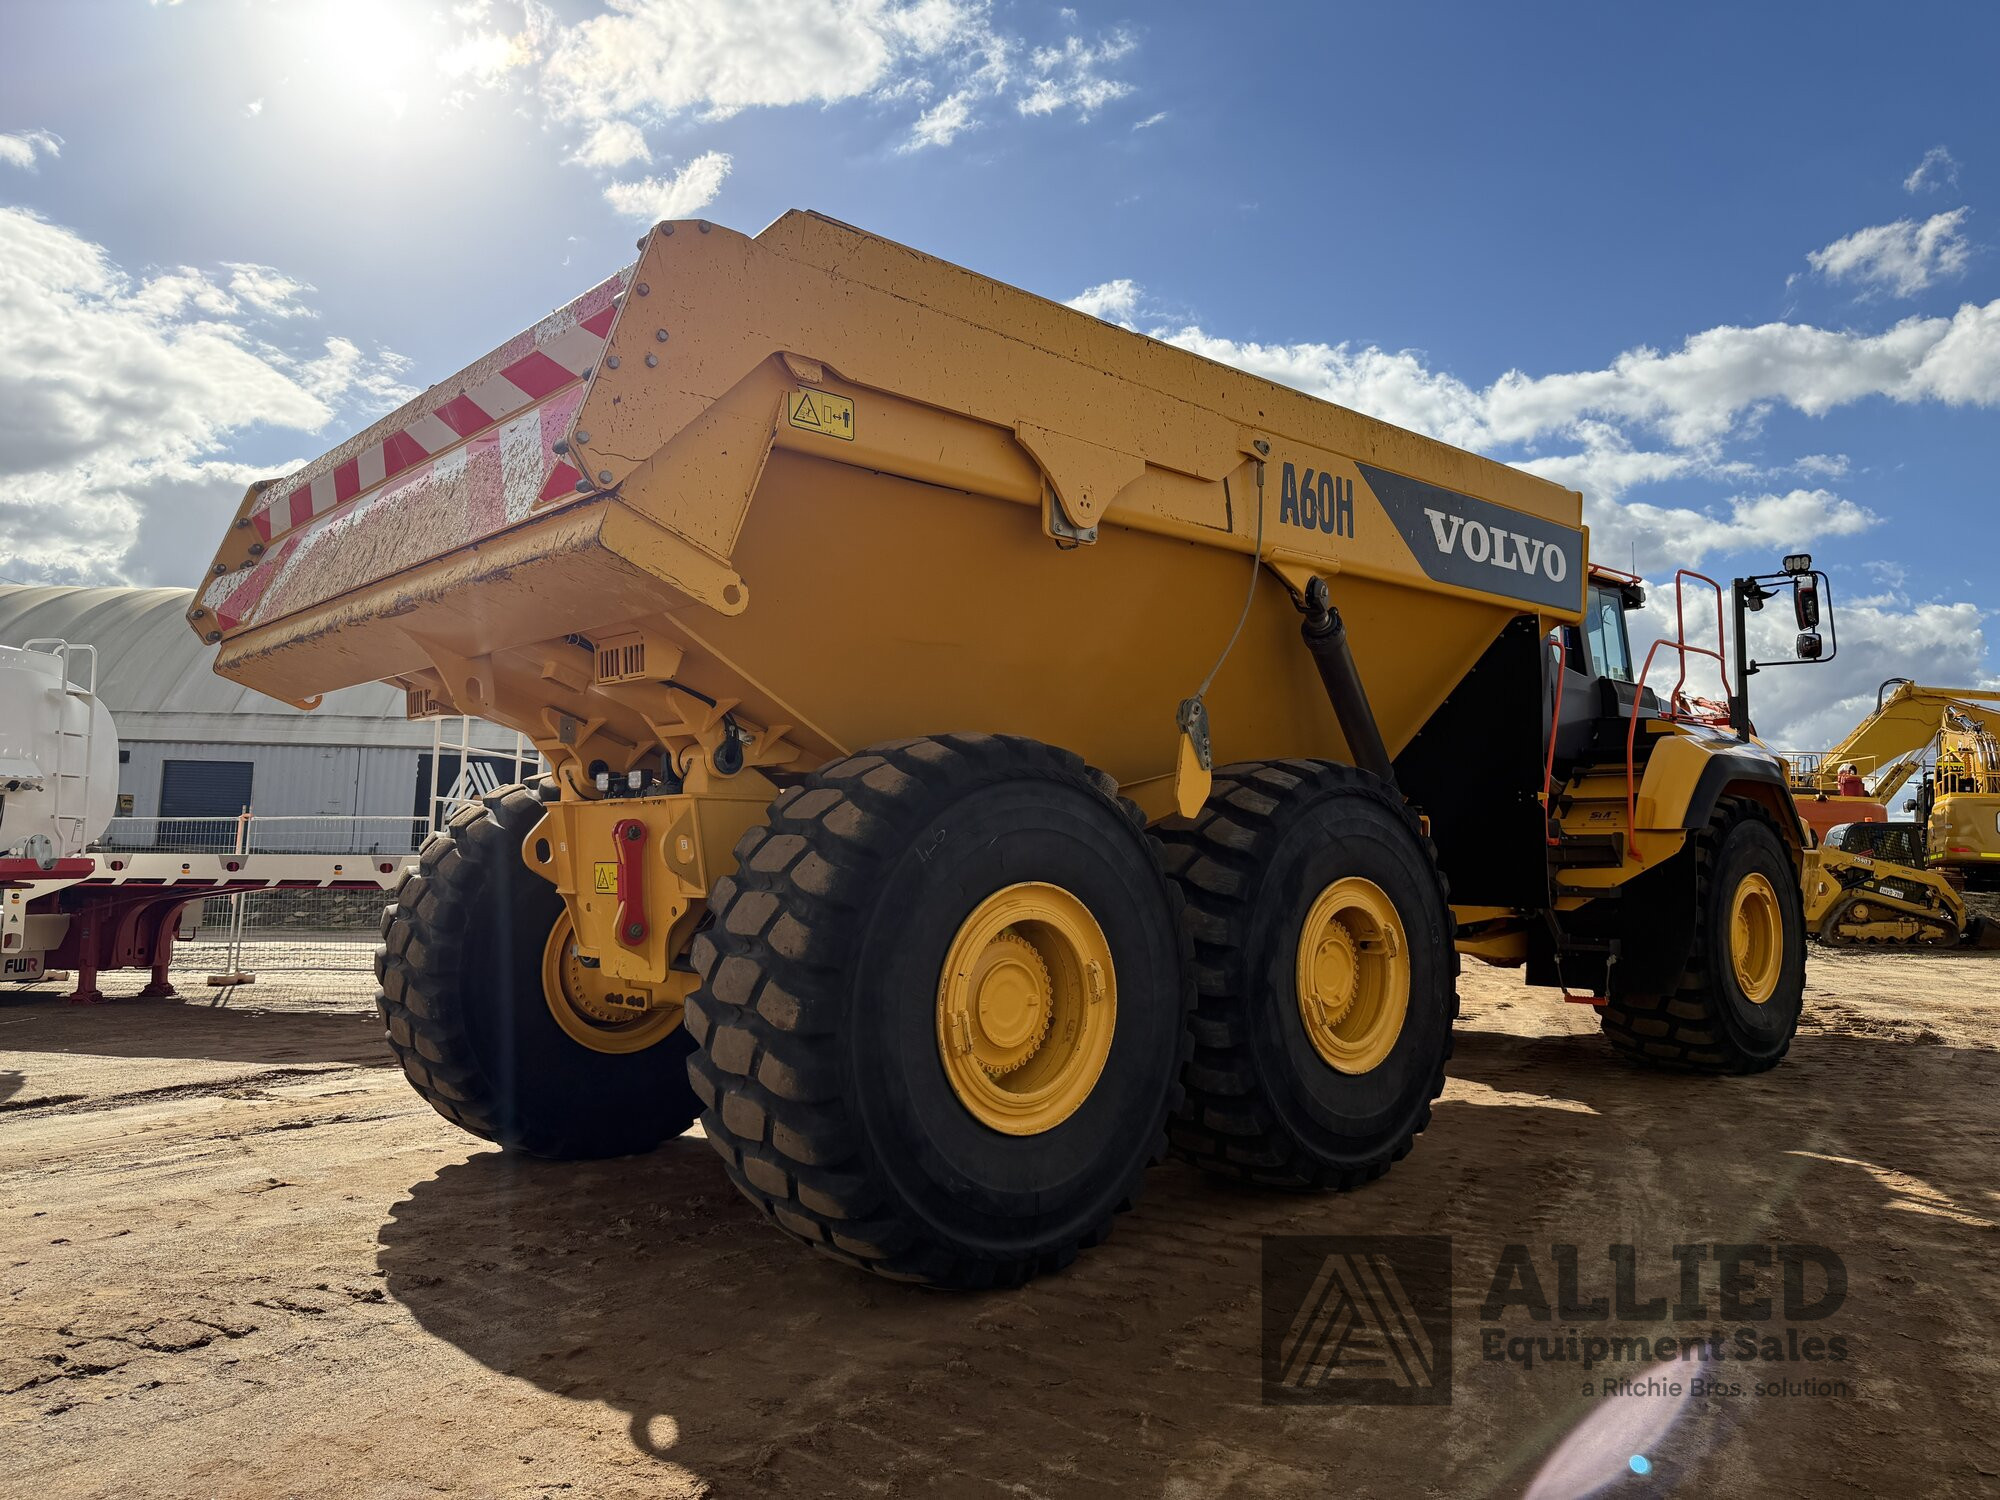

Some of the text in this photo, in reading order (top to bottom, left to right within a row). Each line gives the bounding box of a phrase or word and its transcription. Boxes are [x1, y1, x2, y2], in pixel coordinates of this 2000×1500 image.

[1280, 461, 1354, 538] A60H
[1423, 507, 1567, 582] VOLVO
[4, 957, 38, 974] FWR
